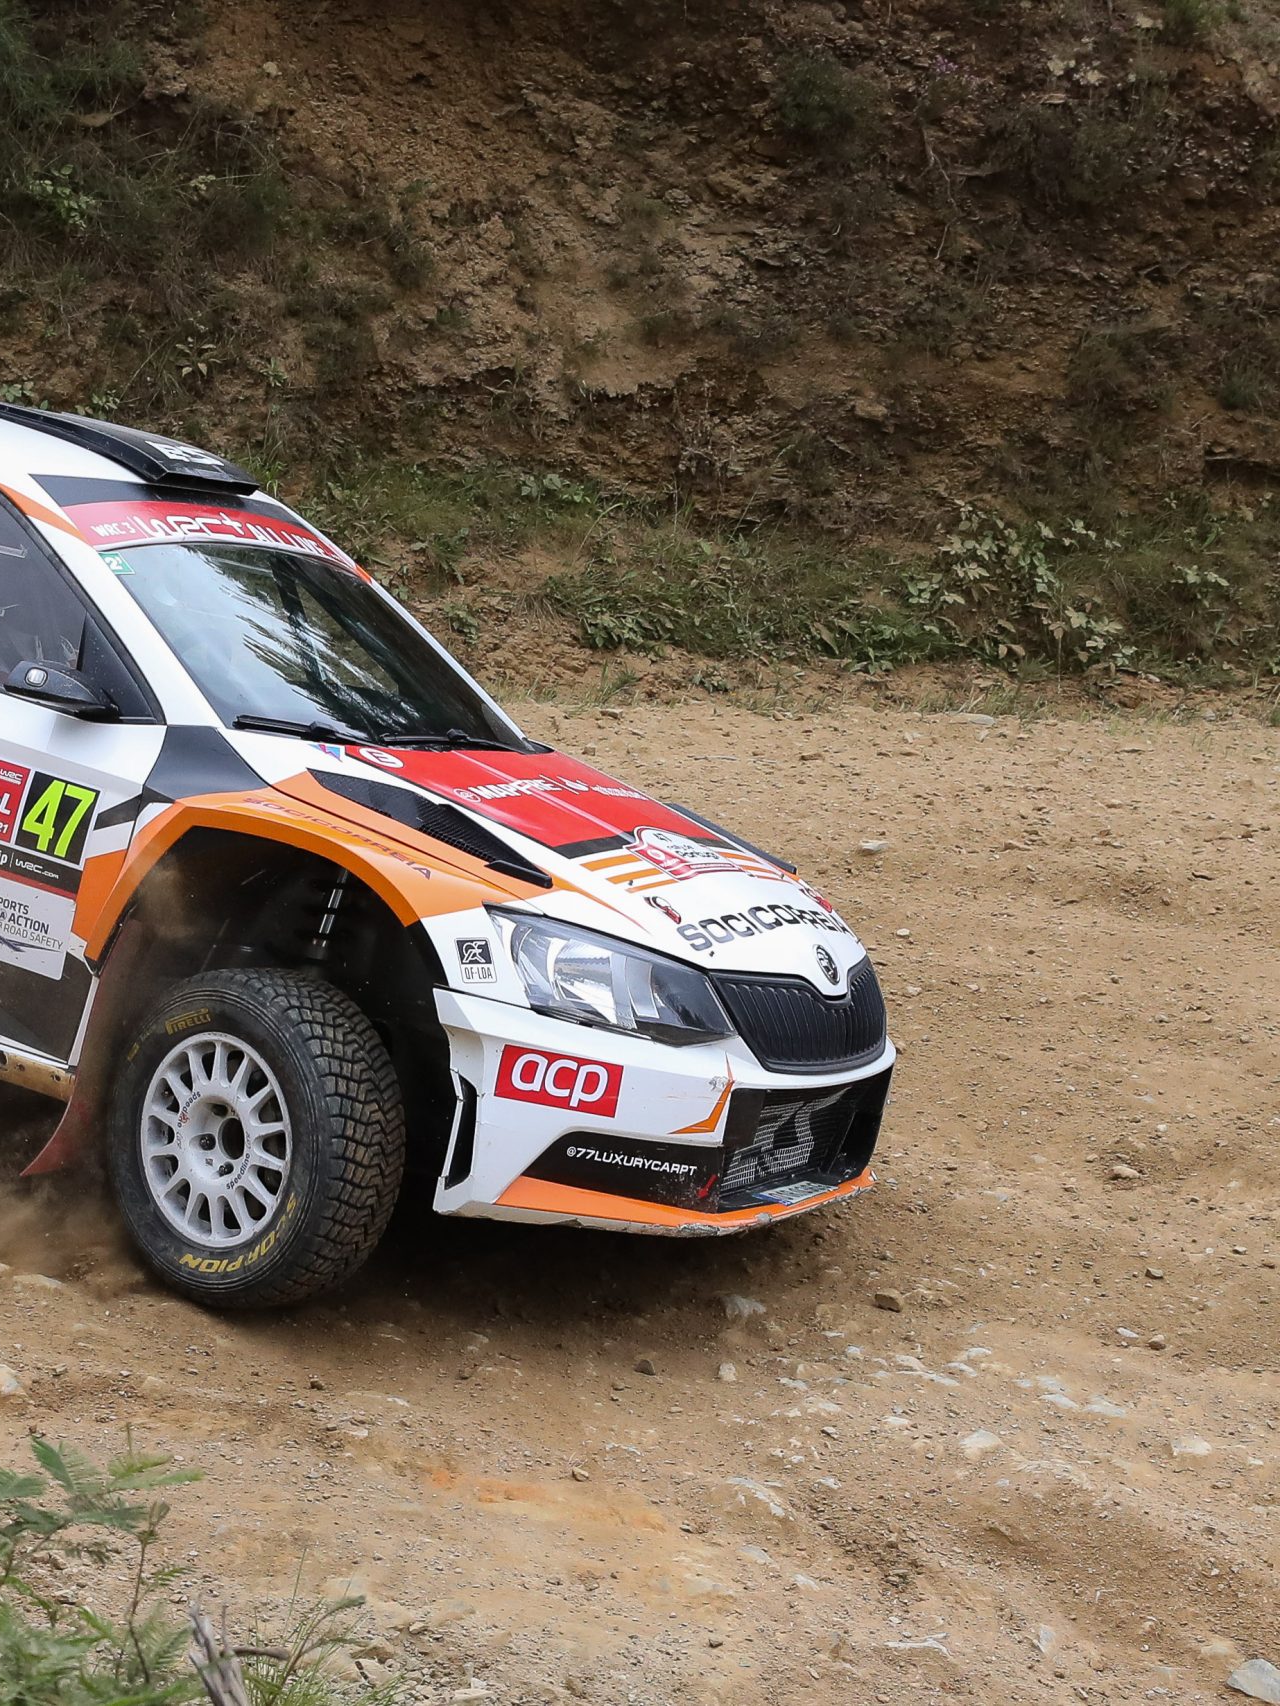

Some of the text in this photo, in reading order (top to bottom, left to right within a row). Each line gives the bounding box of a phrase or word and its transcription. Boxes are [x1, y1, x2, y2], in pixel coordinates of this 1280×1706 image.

[91, 521, 126, 538] WRC
[122, 521, 136, 534] 3
[22, 779, 97, 858] 47
[3, 923, 28, 939] ROAD
[29, 931, 63, 950] SAFETY
[8, 913, 49, 935] ACTION
[165, 1008, 211, 1035] PIRELLI
[511, 1053, 609, 1108] acp
[566, 1146, 698, 1176] @77LUXURYCARPT
